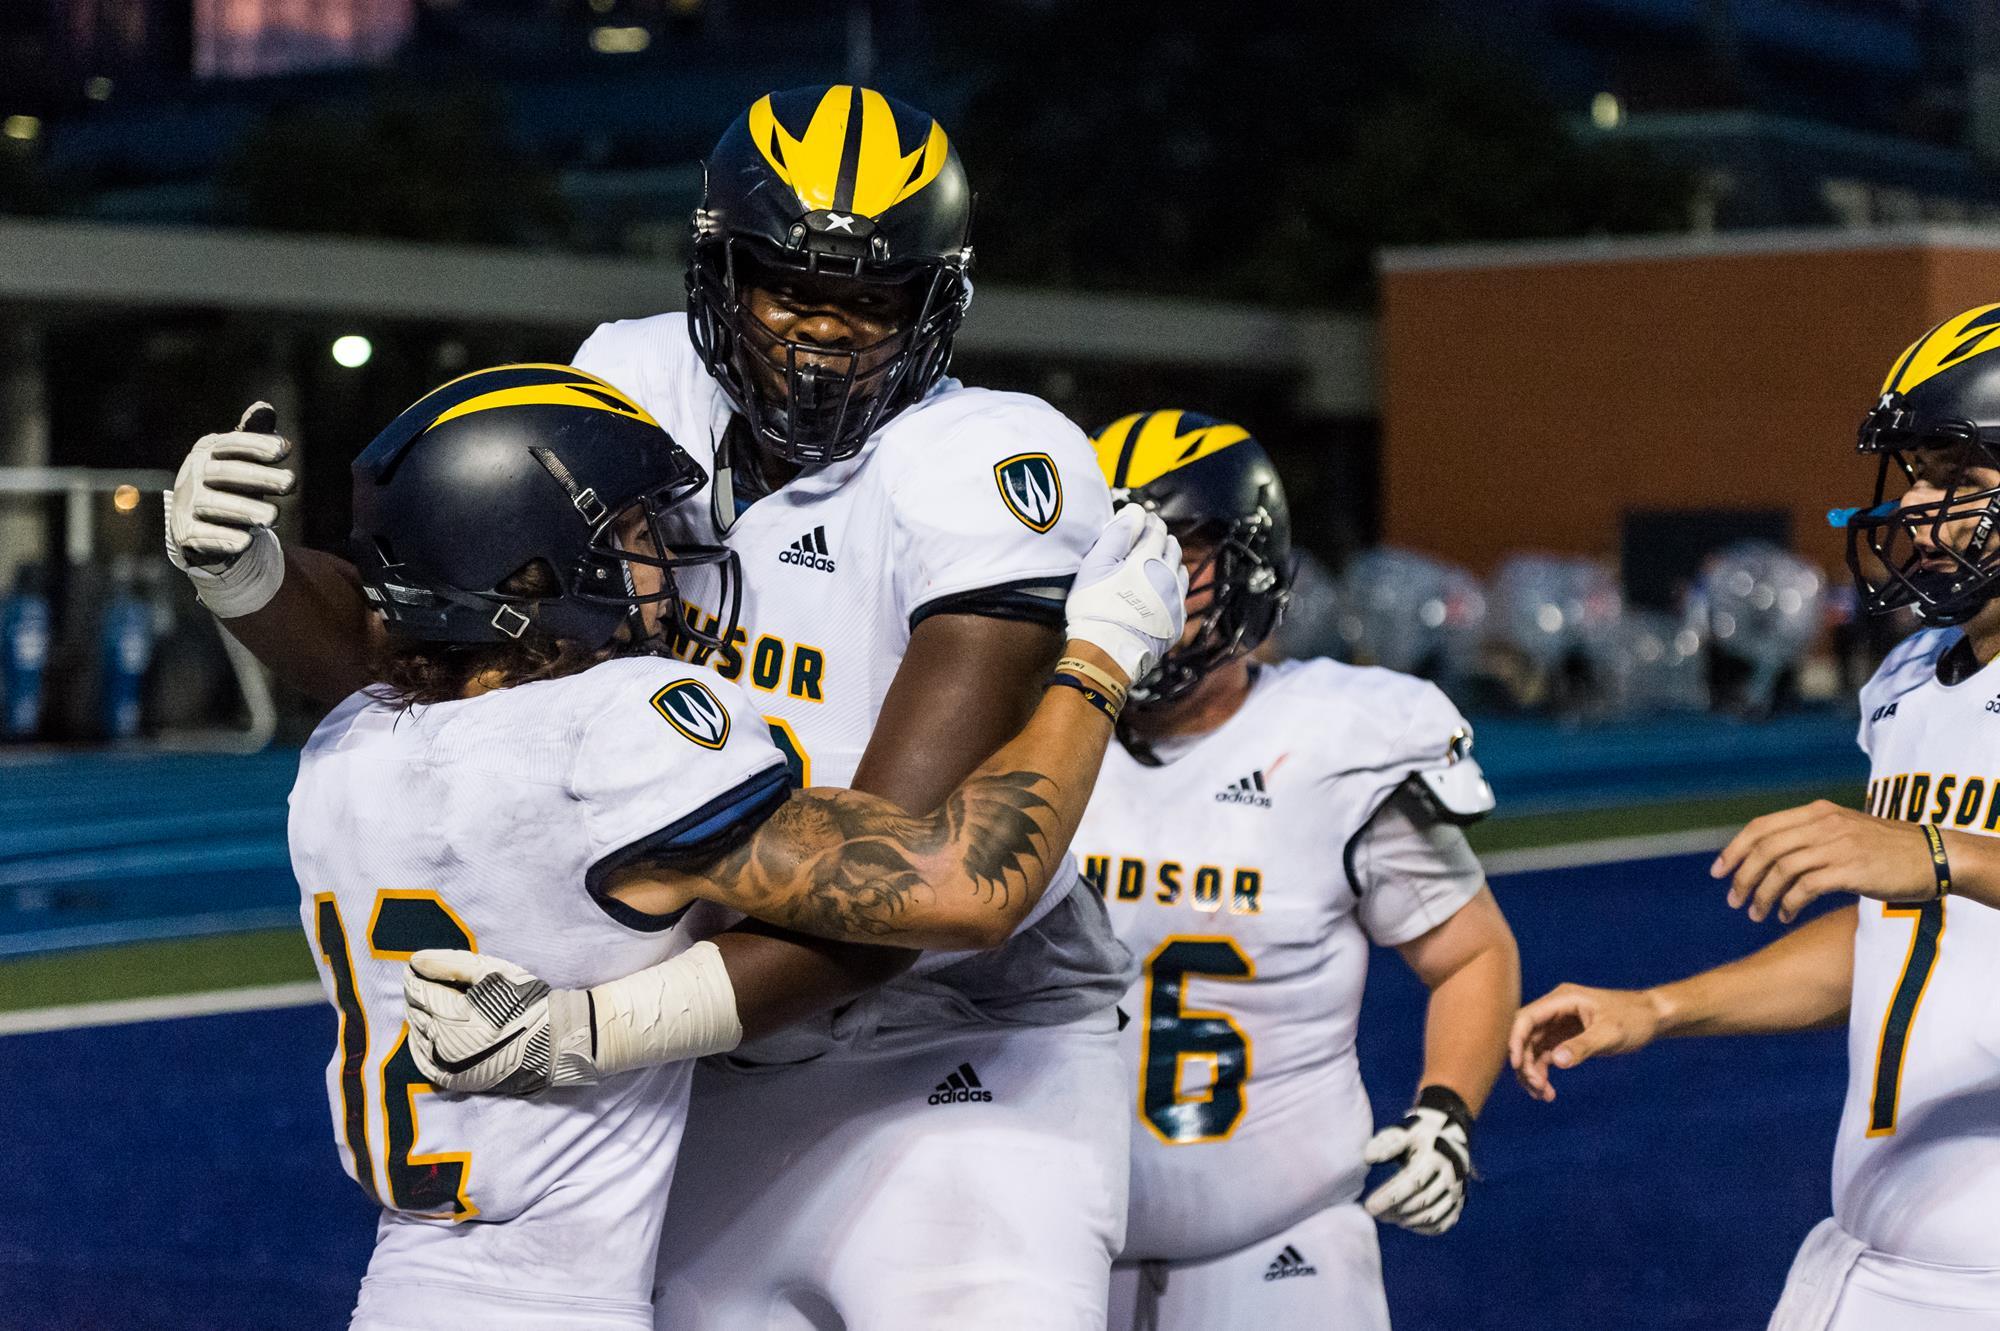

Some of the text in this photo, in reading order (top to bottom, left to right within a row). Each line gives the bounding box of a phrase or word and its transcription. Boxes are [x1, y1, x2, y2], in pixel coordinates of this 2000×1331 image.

[1971, 495, 2000, 549] XENT
[621, 560, 639, 616] XENIH
[779, 549, 836, 574] adidas
[1870, 701, 1899, 722] UA
[1214, 789, 1273, 810] adidas
[1083, 854, 1264, 916] NDSOR
[313, 888, 481, 1223] 12
[1137, 933, 1258, 1147] 6
[927, 1085, 993, 1106] adidas
